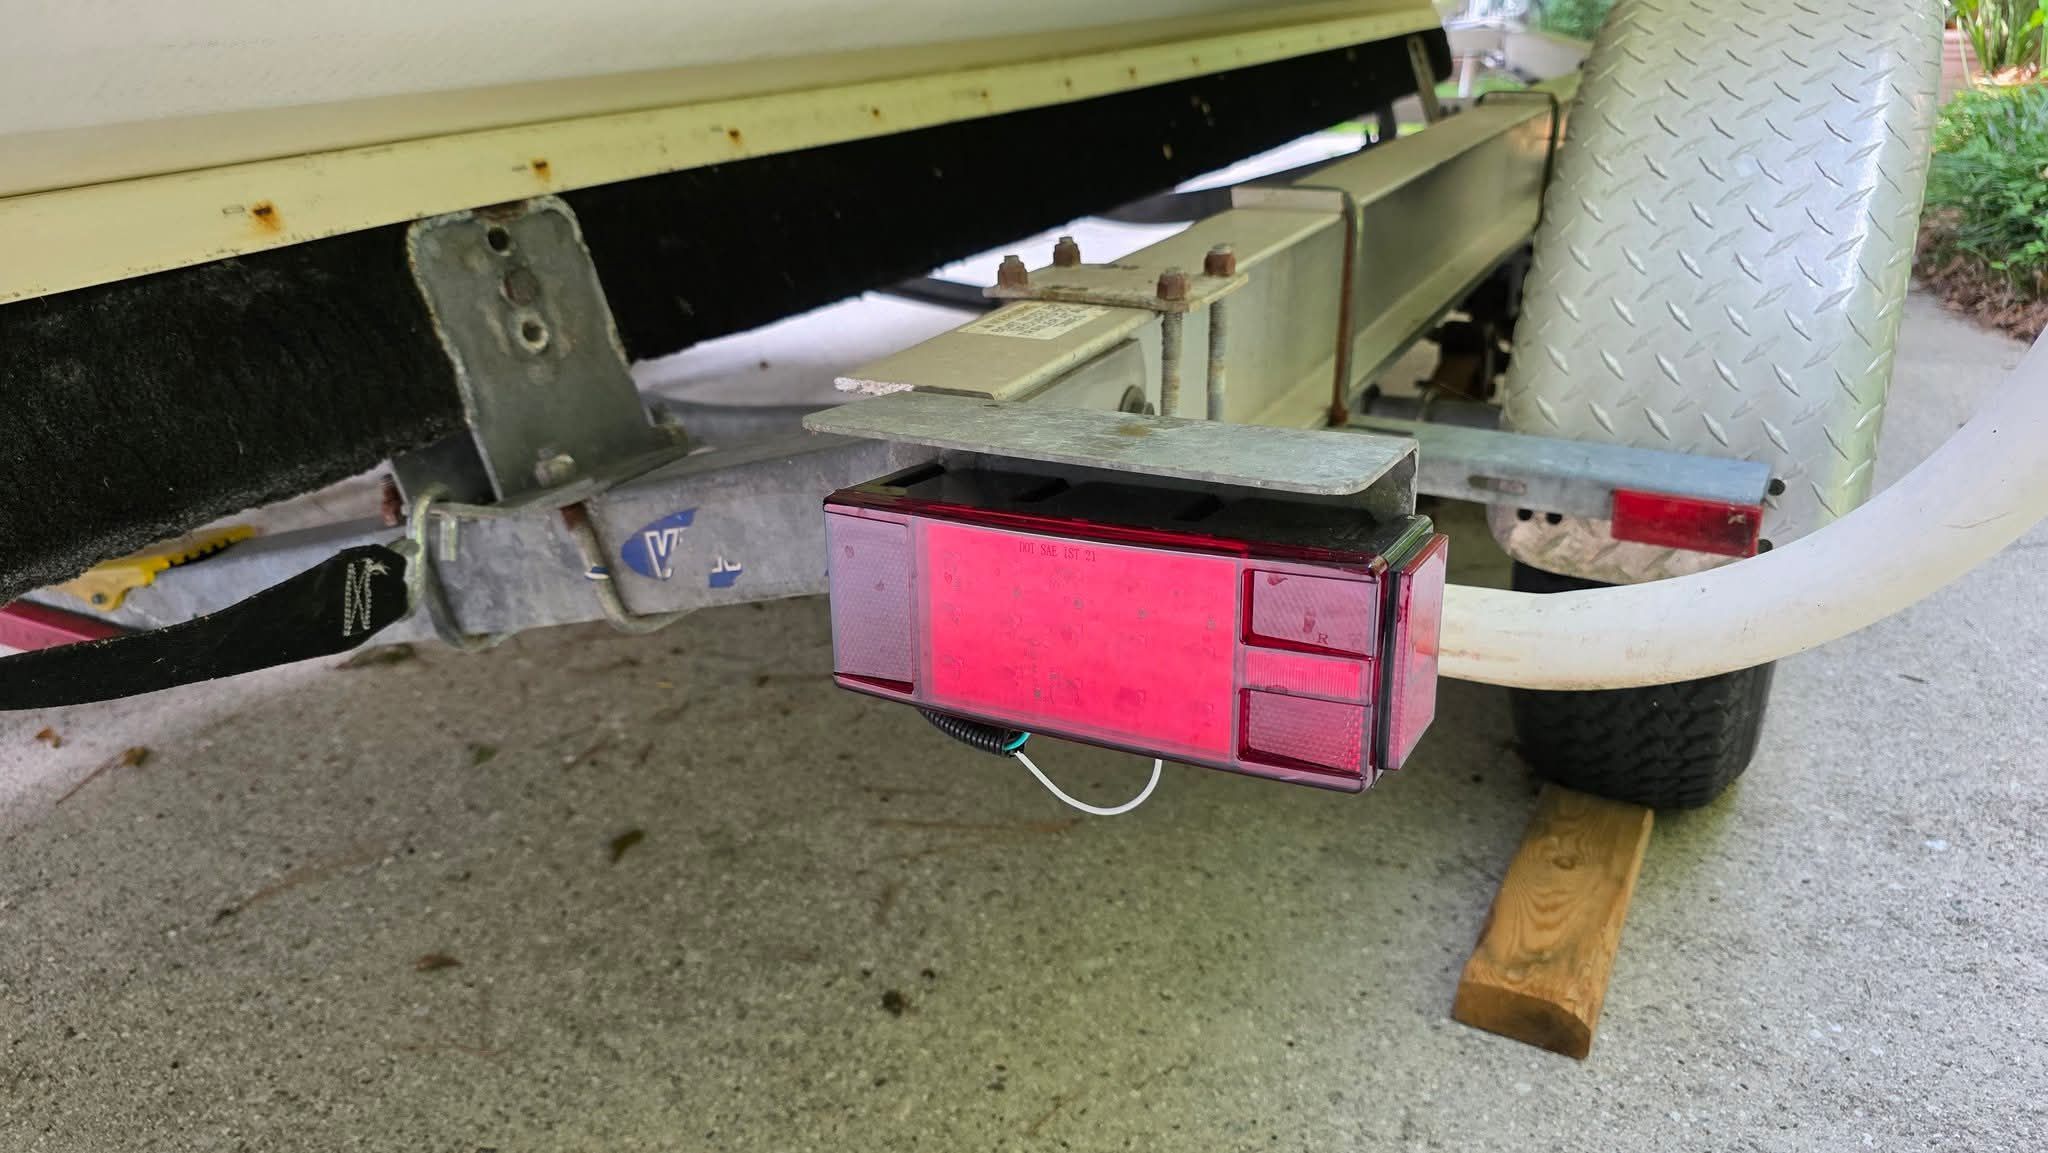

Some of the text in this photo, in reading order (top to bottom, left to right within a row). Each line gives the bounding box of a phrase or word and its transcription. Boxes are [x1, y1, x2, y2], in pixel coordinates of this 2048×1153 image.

[1019, 541, 1035, 554] DOT
[1040, 543, 1058, 557] SAE
[1085, 550, 1096, 562] 21
[1318, 633, 1329, 645] R
